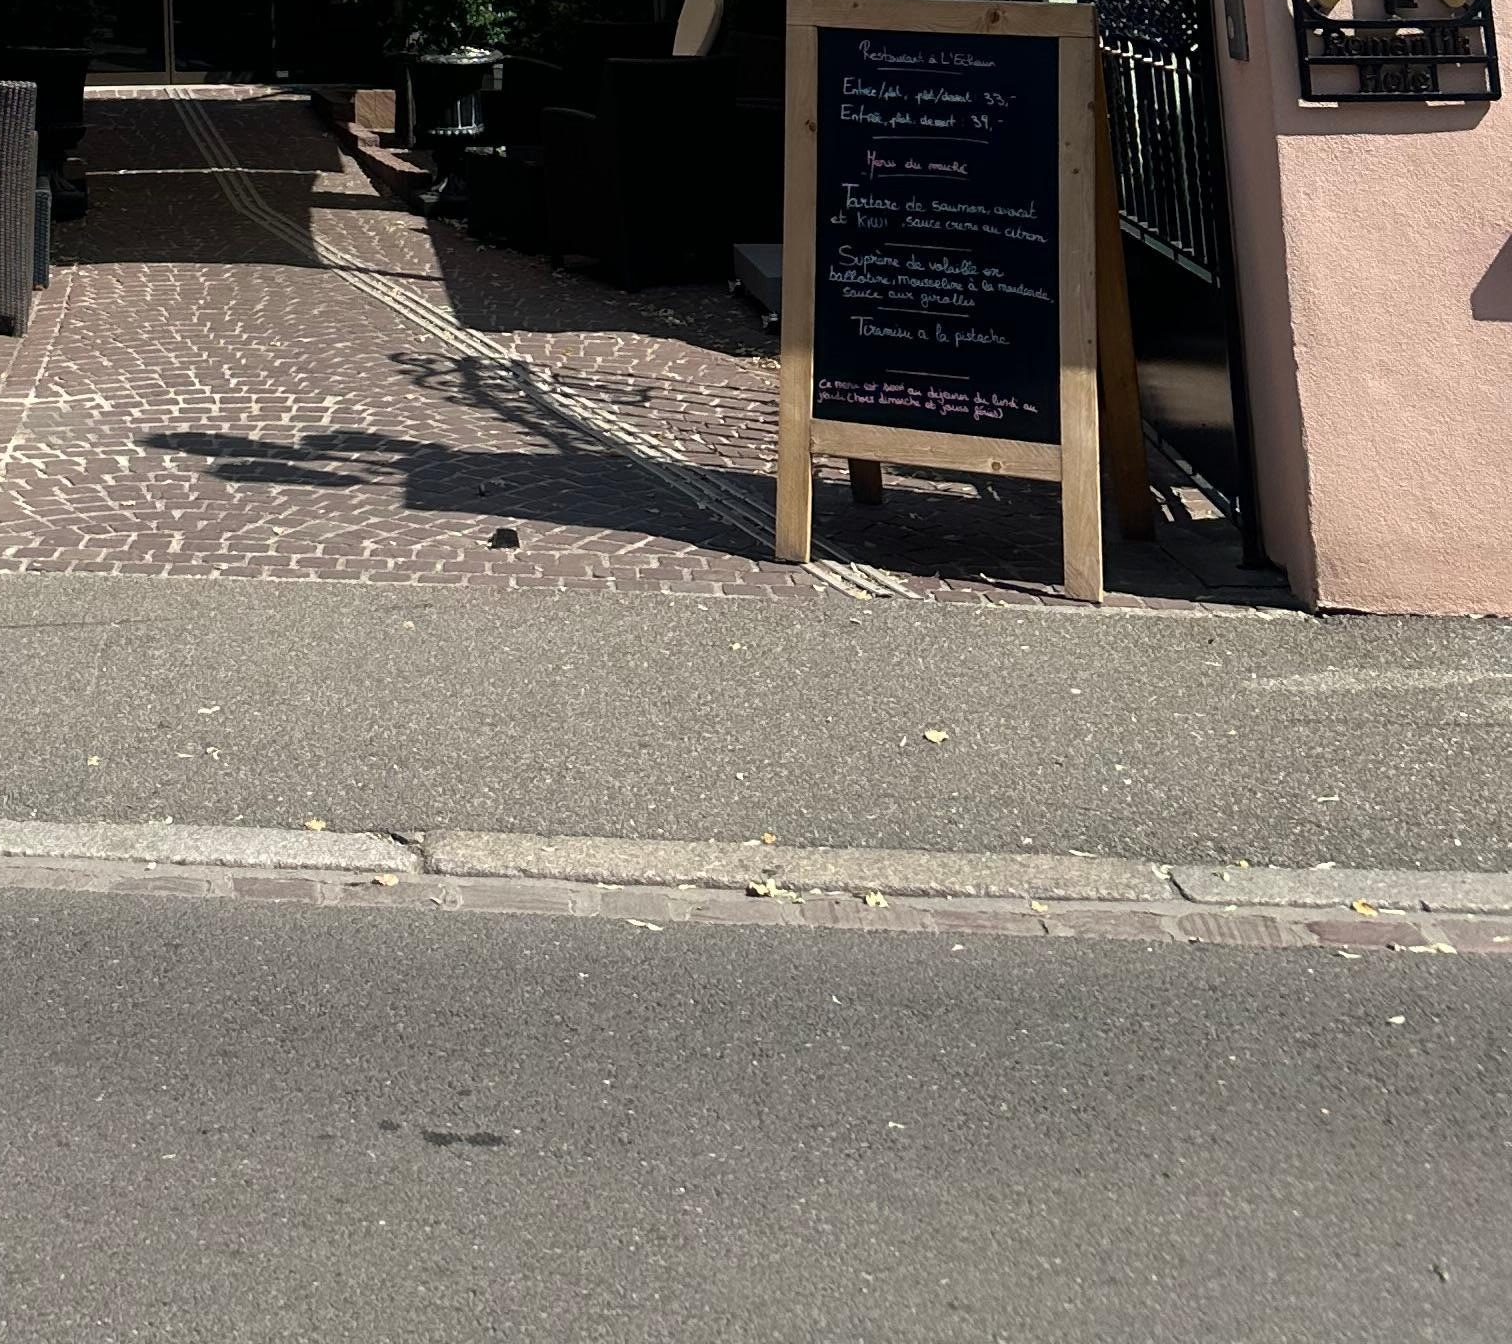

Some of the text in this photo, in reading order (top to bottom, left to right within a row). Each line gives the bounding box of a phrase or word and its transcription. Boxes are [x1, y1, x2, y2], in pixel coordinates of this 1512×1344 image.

[858, 39, 925, 64] Restaurant
[841, 182, 900, 210] Tartare
[905, 195, 926, 212] de
[830, 209, 848, 225] et
[982, 223, 1002, 235] au
[1004, 222, 1048, 243] citron
[905, 253, 926, 271] de
[841, 286, 976, 308] sauce aux girolles
[981, 278, 995, 292] la
[849, 315, 914, 340] Tiramisu
[935, 322, 950, 343] la
[954, 327, 1011, 348] pistache
[907, 386, 922, 396] au
[973, 391, 989, 405] du
[991, 393, 1020, 409] lundi
[1022, 401, 1039, 413] au
